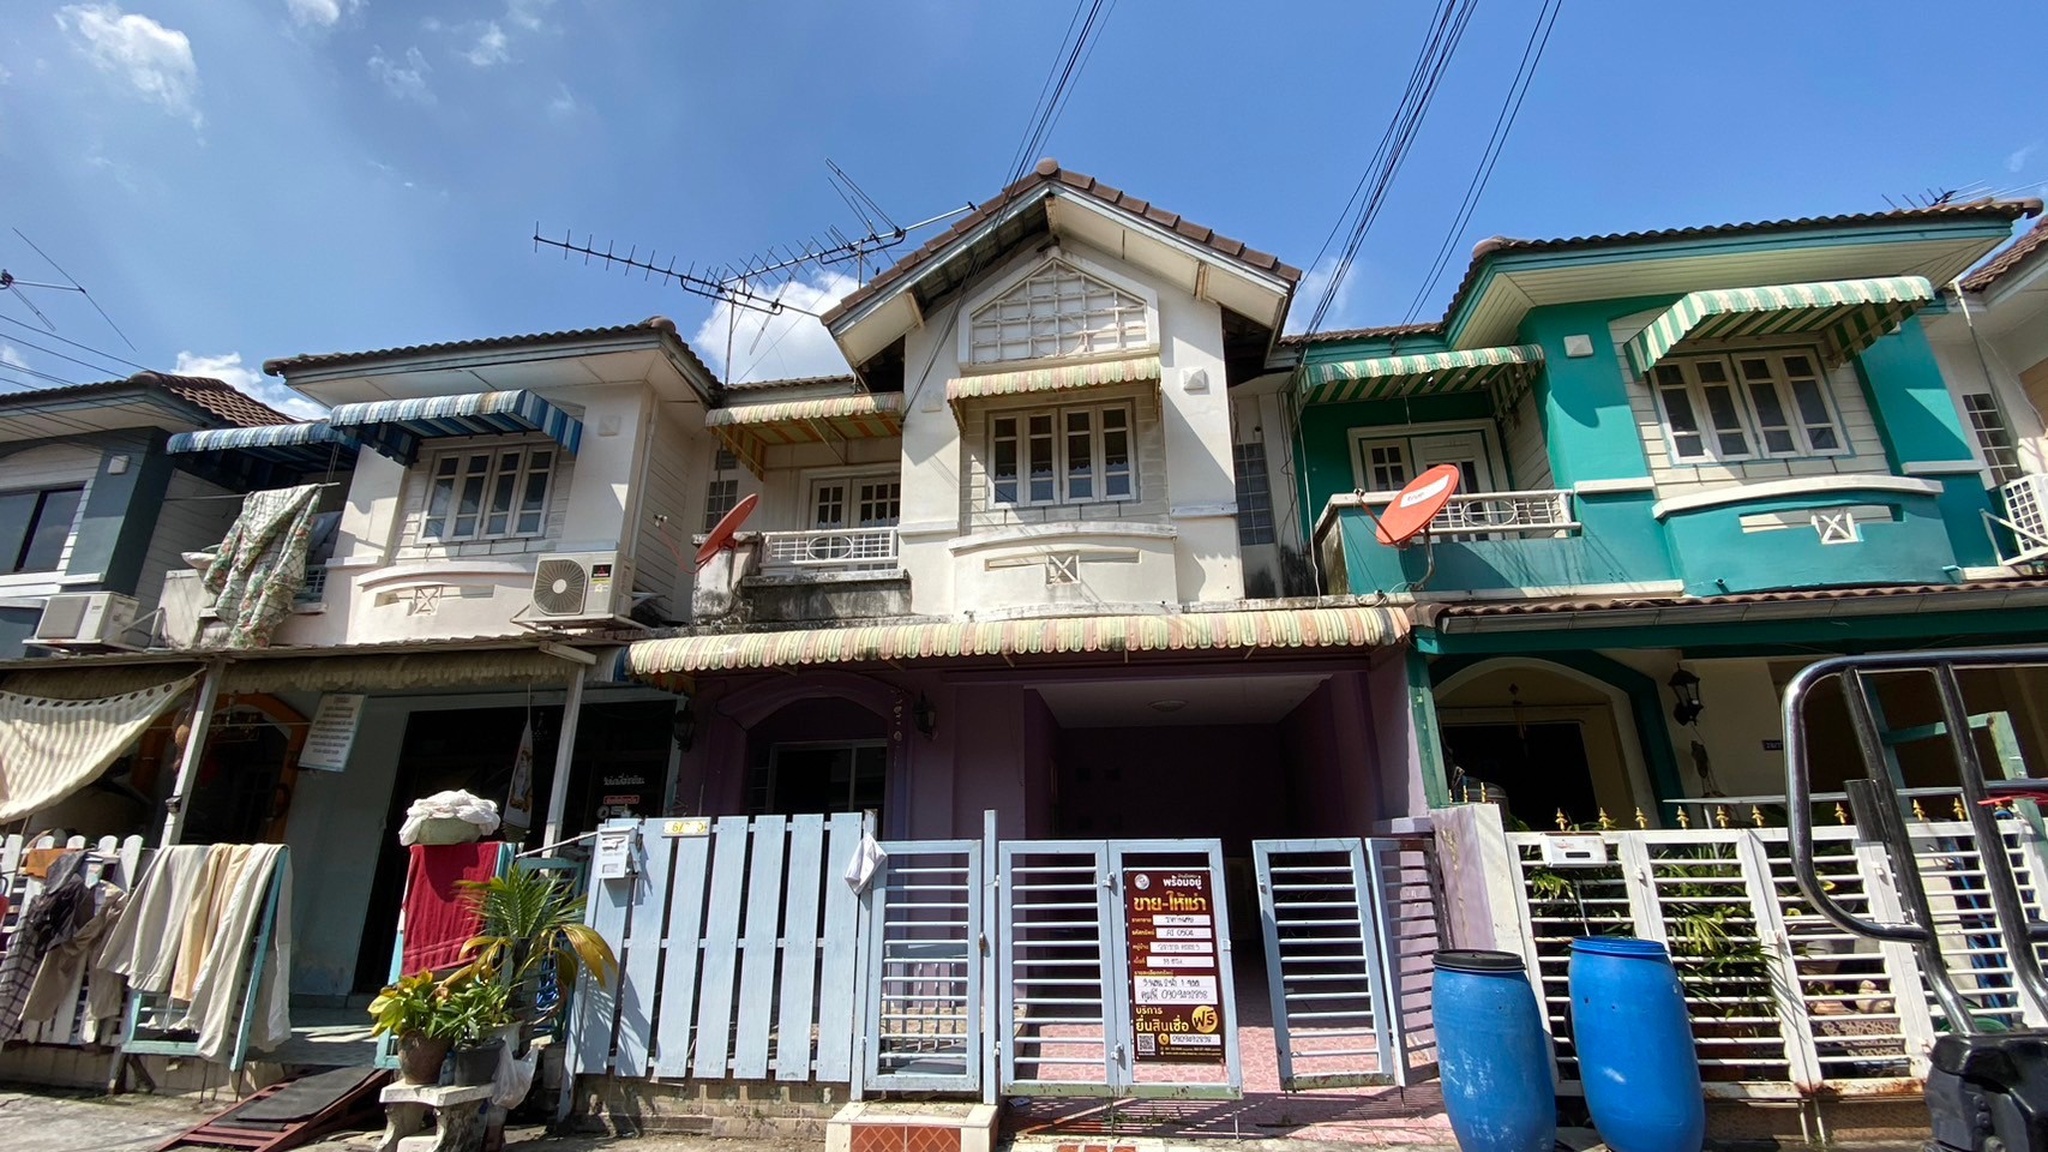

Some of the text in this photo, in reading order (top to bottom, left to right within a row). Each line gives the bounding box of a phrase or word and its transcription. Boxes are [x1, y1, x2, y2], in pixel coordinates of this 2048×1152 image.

[1163, 874, 1202, 890] พร้อมอยู่
[1133, 890, 1207, 911] ขาย-ให้เช่า
[1136, 1005, 1163, 1014] บริการ
[1136, 1015, 1190, 1032] ยื่นสินเชื่อ
[1193, 1009, 1215, 1028] ฟรี
